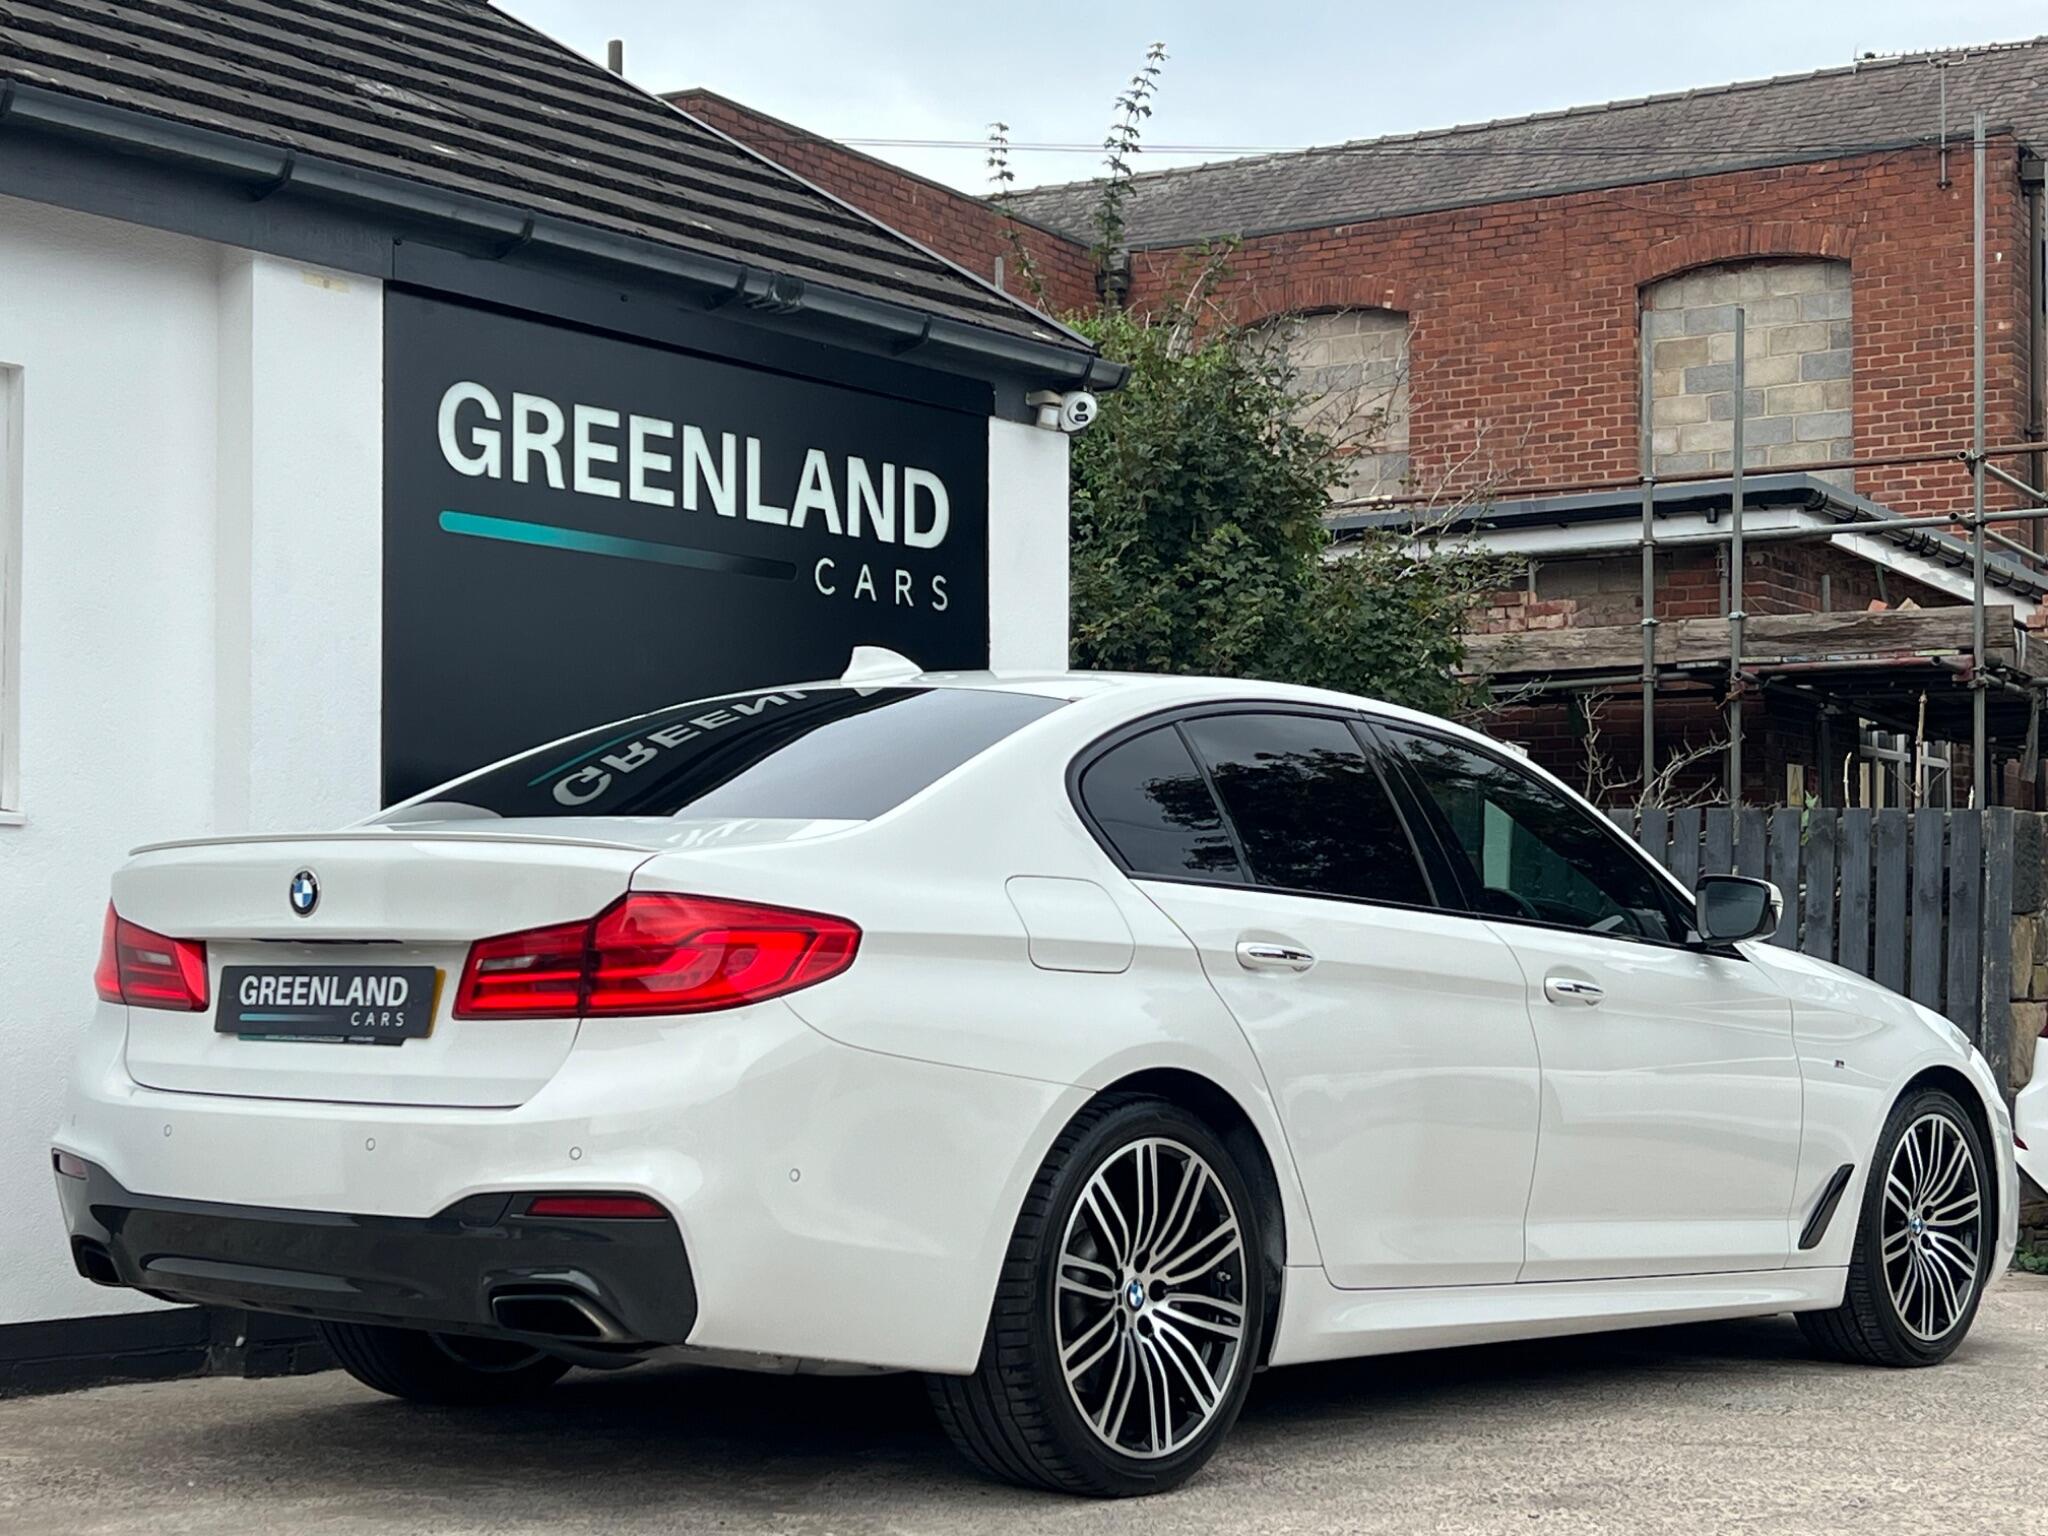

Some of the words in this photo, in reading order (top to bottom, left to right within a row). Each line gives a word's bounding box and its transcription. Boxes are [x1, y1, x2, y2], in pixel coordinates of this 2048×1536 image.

[437, 381, 950, 549] GREENLAND
[814, 557, 949, 611] CARS
[239, 975, 409, 1007] GREENLAND
[350, 1011, 404, 1027] CARS
